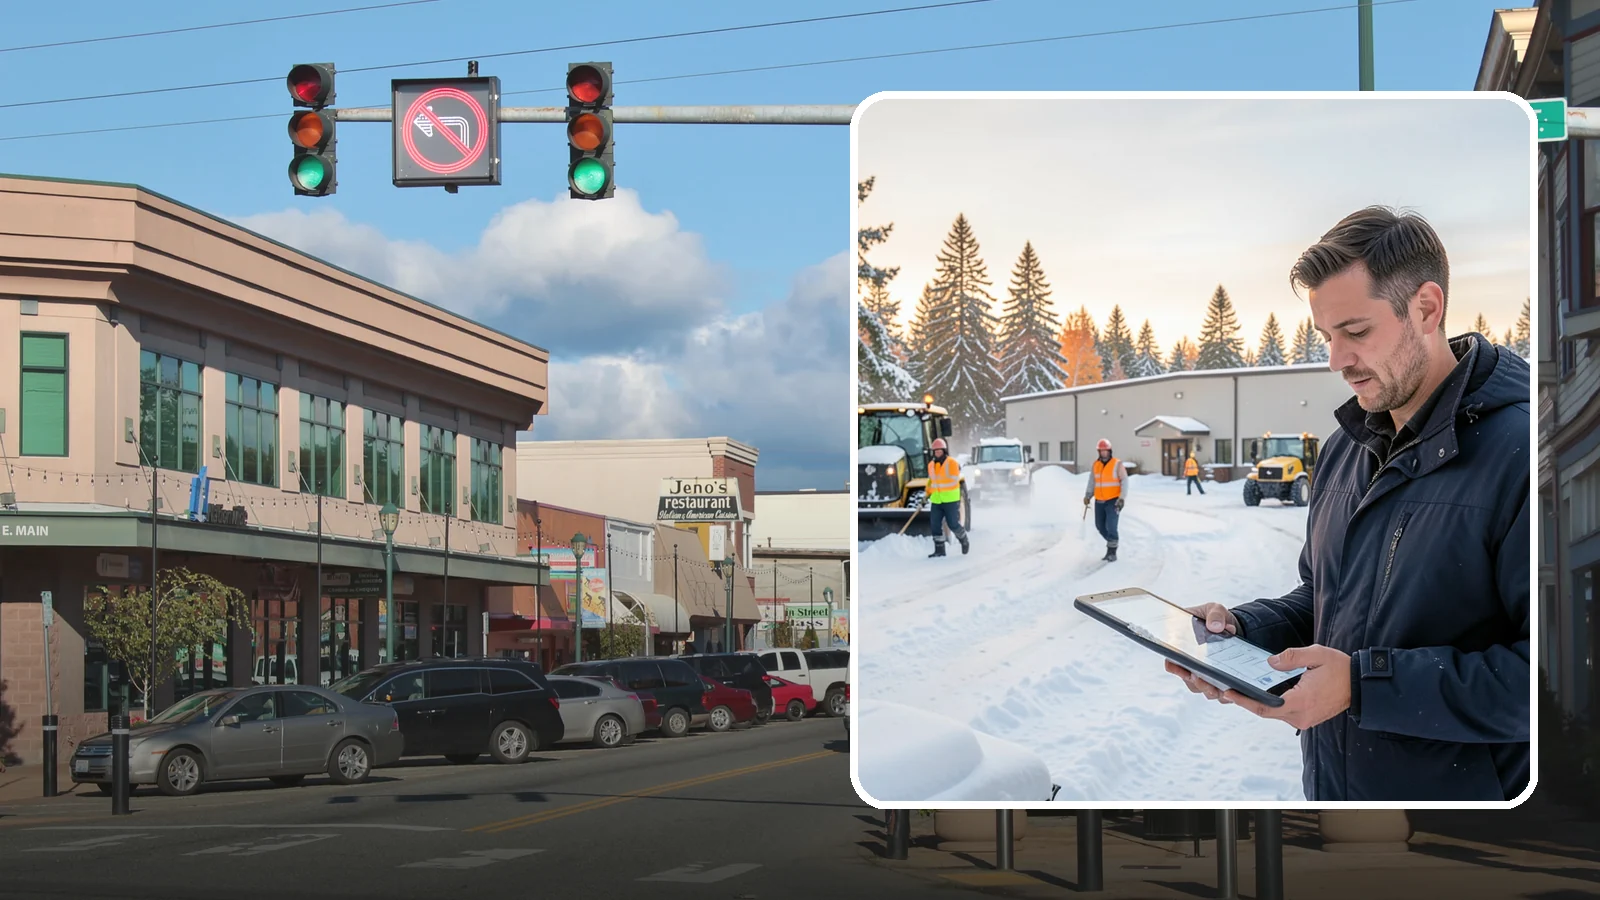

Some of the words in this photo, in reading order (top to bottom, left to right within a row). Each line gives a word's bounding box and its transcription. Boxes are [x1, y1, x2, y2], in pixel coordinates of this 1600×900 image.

[670, 480, 727, 494] Jeno's
[665, 497, 731, 509] restaurant
[686, 510, 714, 519] American
[715, 510, 737, 519] Cuisine
[2, 525, 13, 536] E.
[15, 525, 49, 536] MAIN
[797, 607, 829, 617] Street
[790, 619, 823, 627] lass
